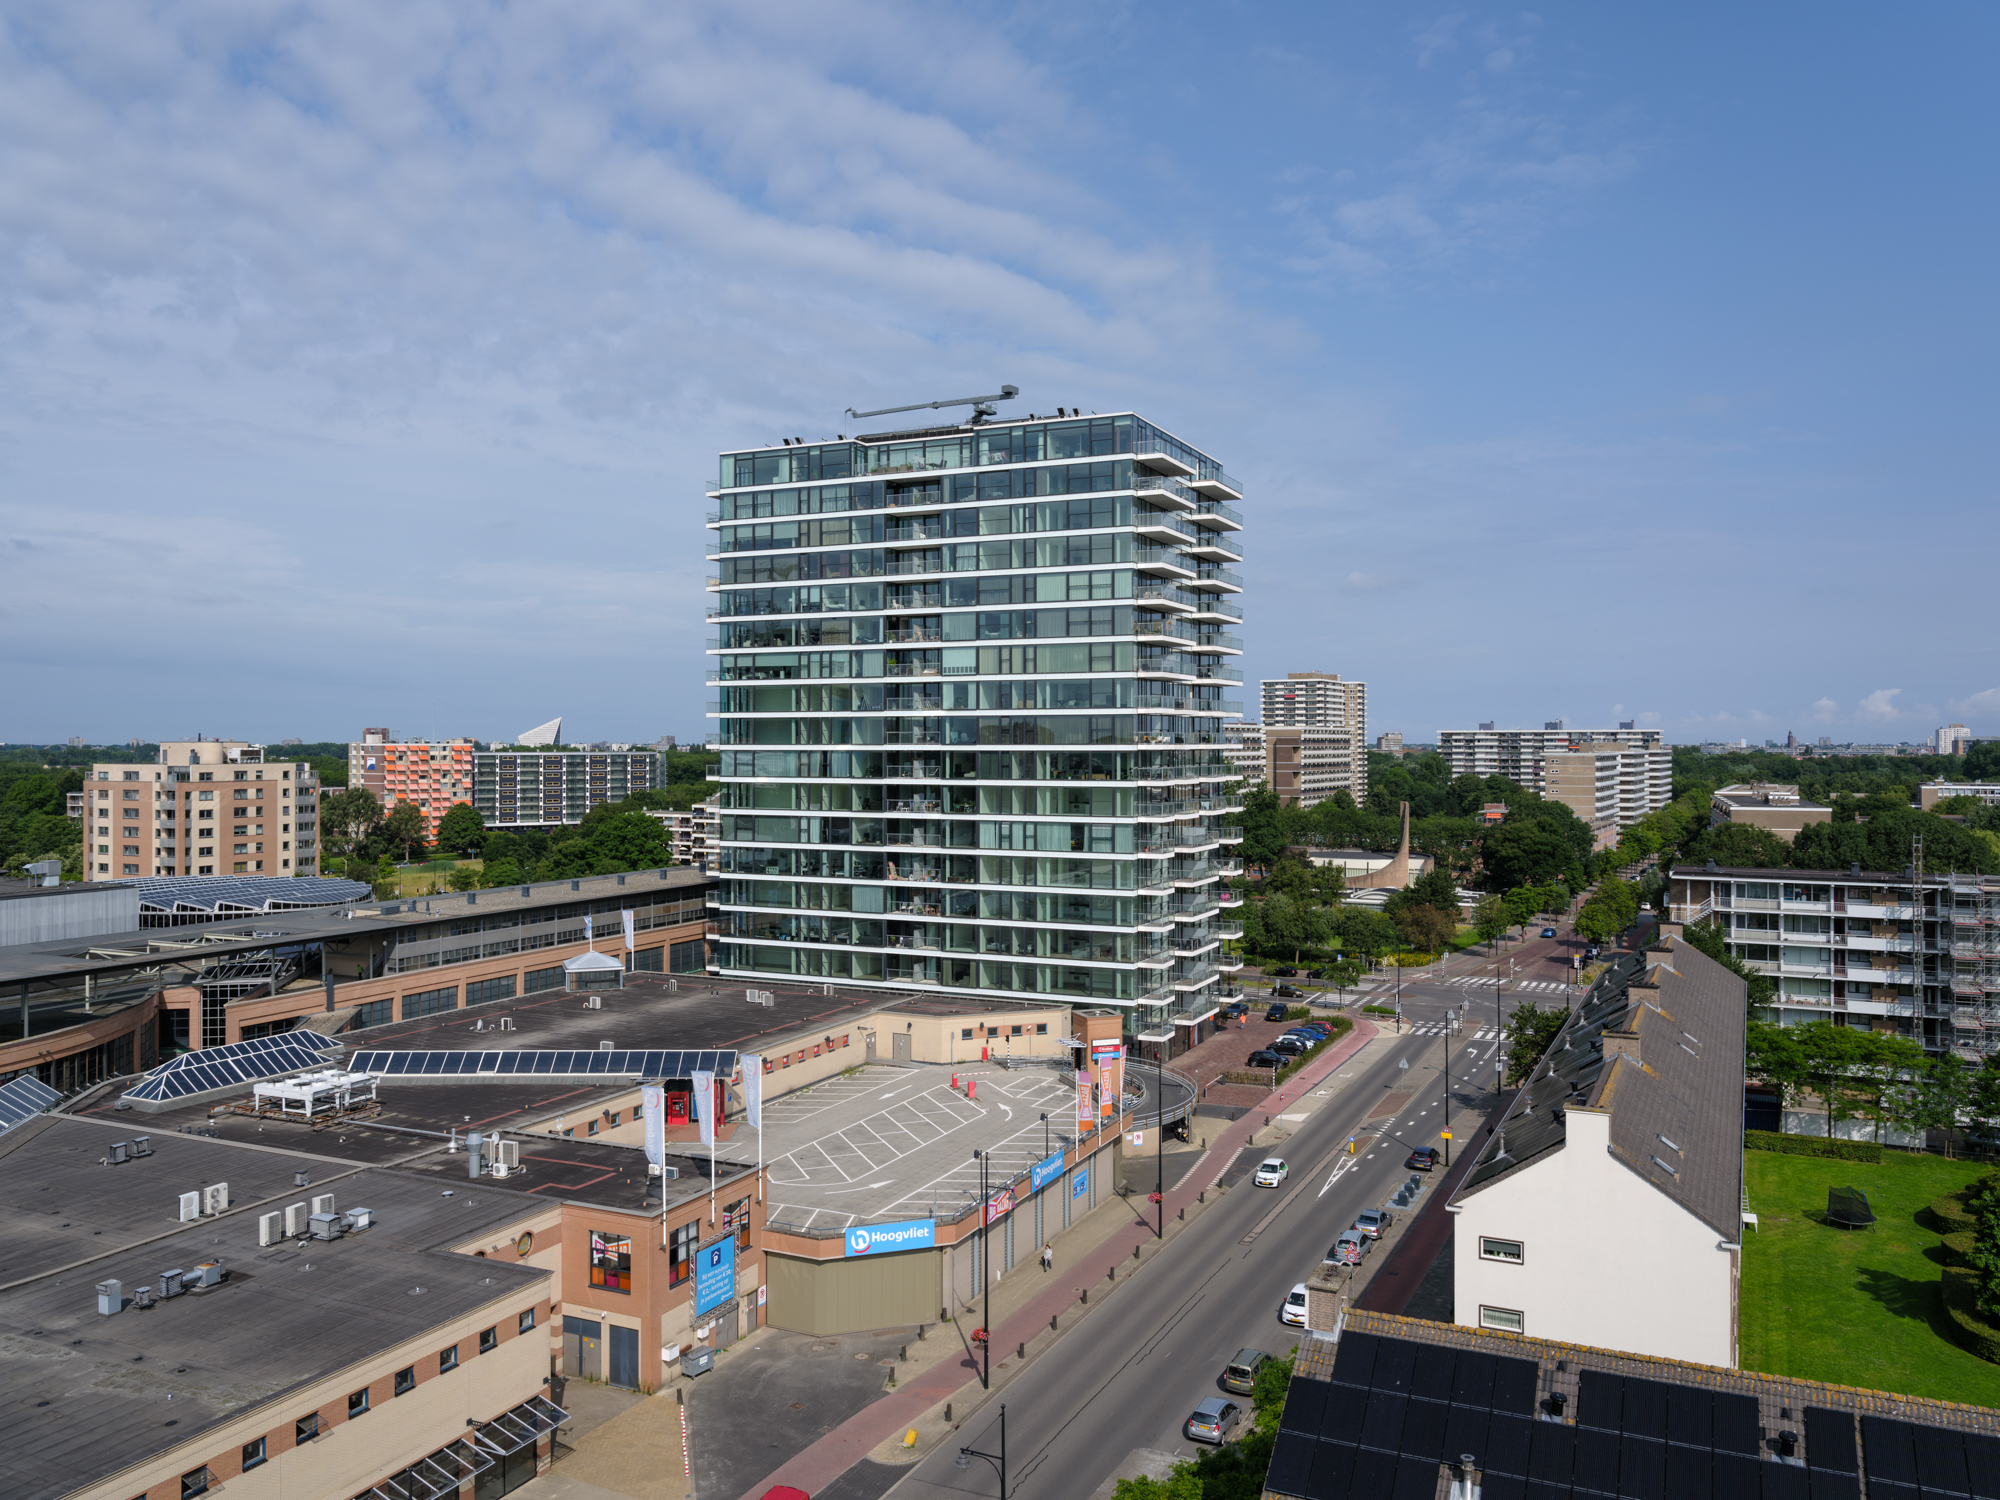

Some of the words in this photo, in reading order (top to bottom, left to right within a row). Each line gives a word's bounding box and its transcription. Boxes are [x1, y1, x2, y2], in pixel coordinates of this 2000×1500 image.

[1080, 1086, 1089, 1106] BAZAR
[1082, 1106, 1090, 1117] BIG
[1042, 1157, 1062, 1177] Hoogvliet
[872, 1227, 929, 1242] Hoogvliet
[698, 1278, 716, 1290] besteding
[711, 1281, 723, 1290] korting
